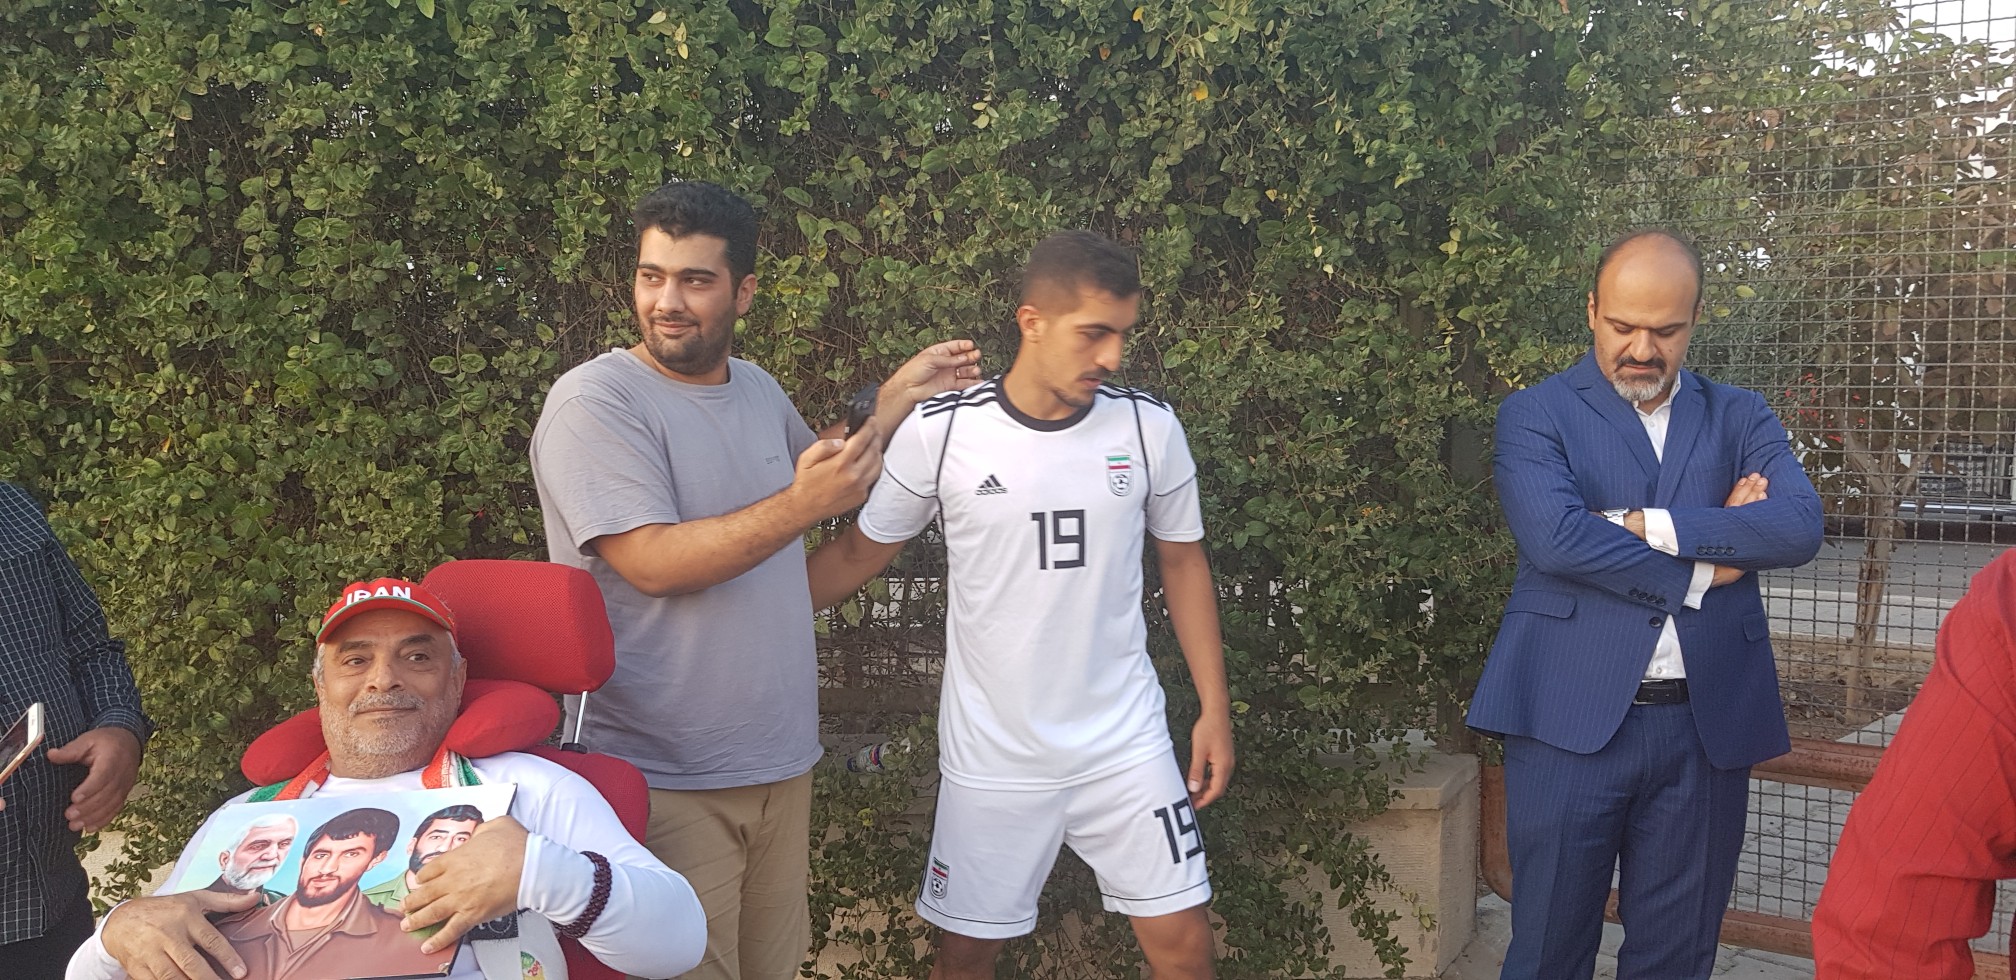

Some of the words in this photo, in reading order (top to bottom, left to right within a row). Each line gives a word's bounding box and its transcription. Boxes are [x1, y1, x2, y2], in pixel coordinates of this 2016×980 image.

[1030, 508, 1086, 571] 19
[346, 586, 411, 606] IRAN
[1153, 796, 1205, 865] 19
